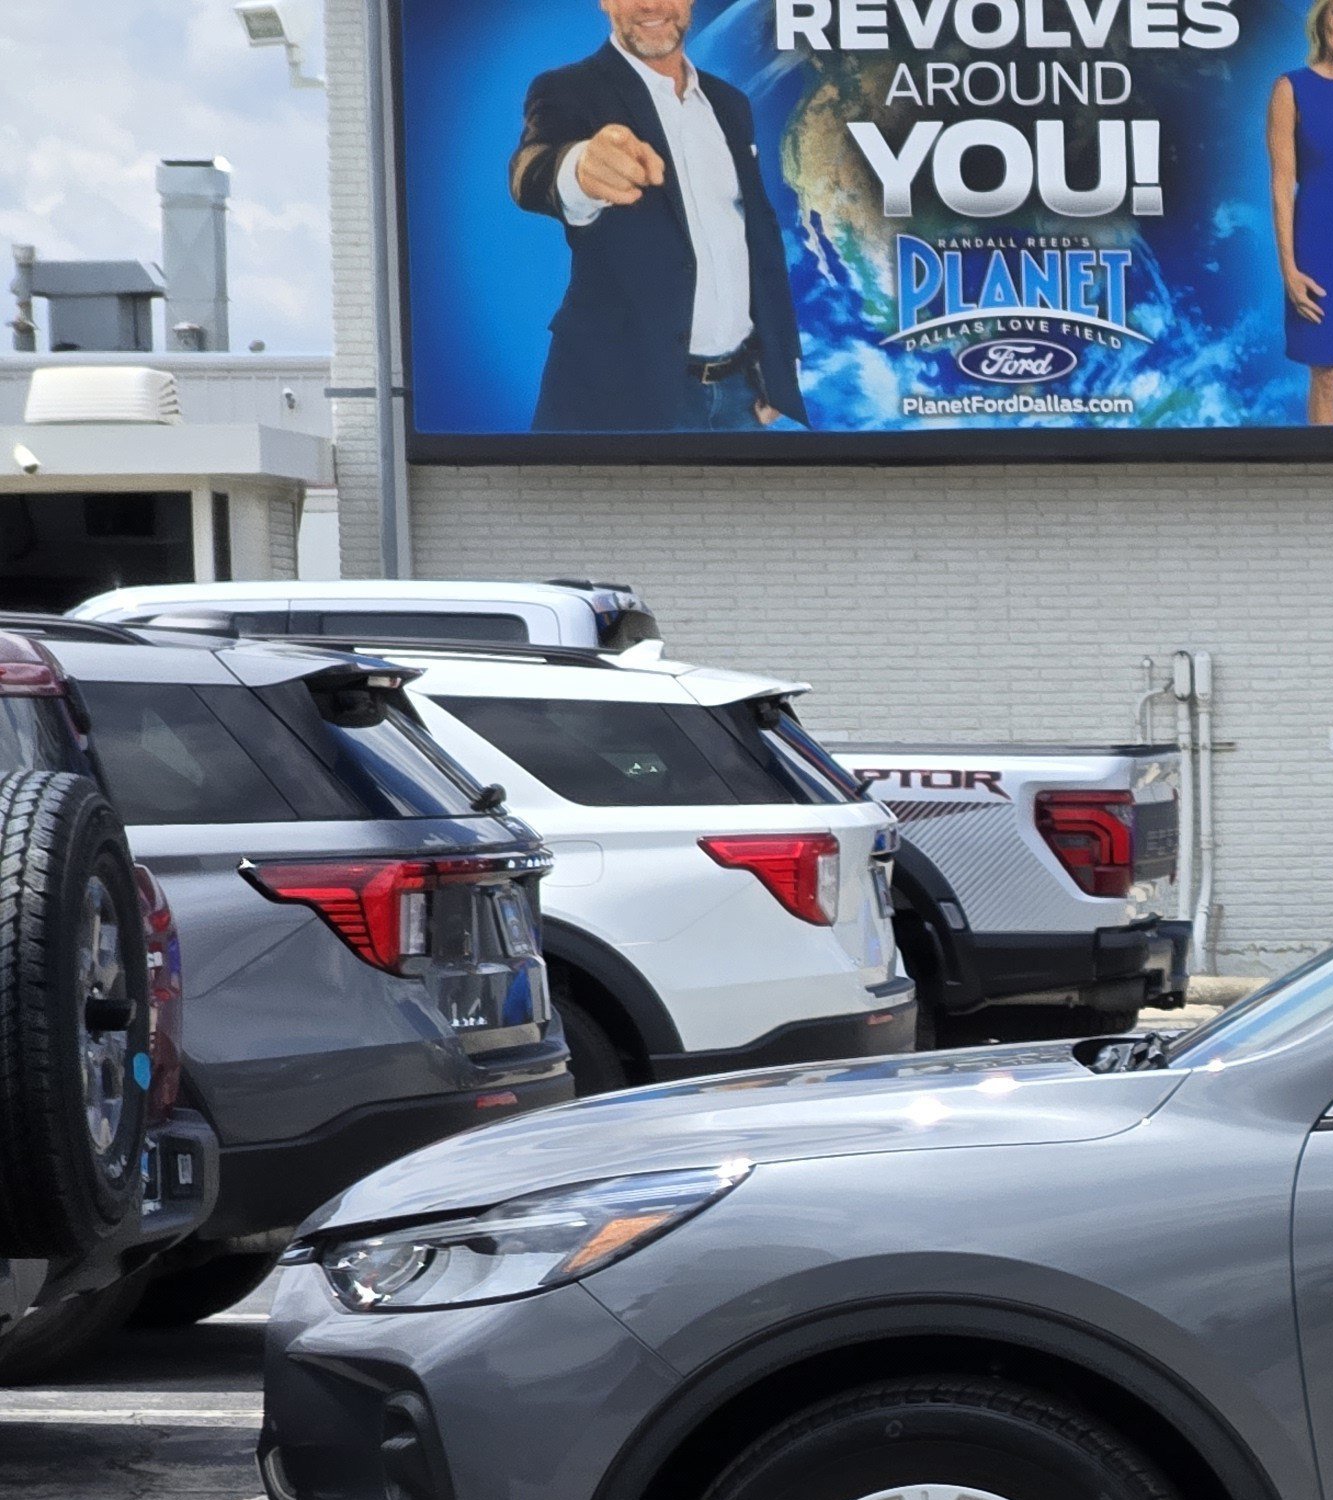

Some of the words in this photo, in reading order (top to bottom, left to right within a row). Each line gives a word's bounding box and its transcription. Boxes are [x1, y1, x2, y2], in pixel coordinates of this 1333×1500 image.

[776, 0, 1240, 50] REVOLVES
[884, 61, 1132, 106] AROUND
[846, 118, 1164, 218] YOU!
[937, 237, 1017, 249] RANDALL
[1026, 236, 1091, 248] REED'S
[896, 233, 1133, 334] PLANET
[905, 321, 985, 352] DALLAS
[996, 319, 1050, 333] LOVE
[1060, 322, 1122, 349] FIELD
[980, 344, 1055, 376] Ford
[902, 394, 1134, 415] PlanetFordDallas.com
[853, 768, 1012, 801] PTOR
